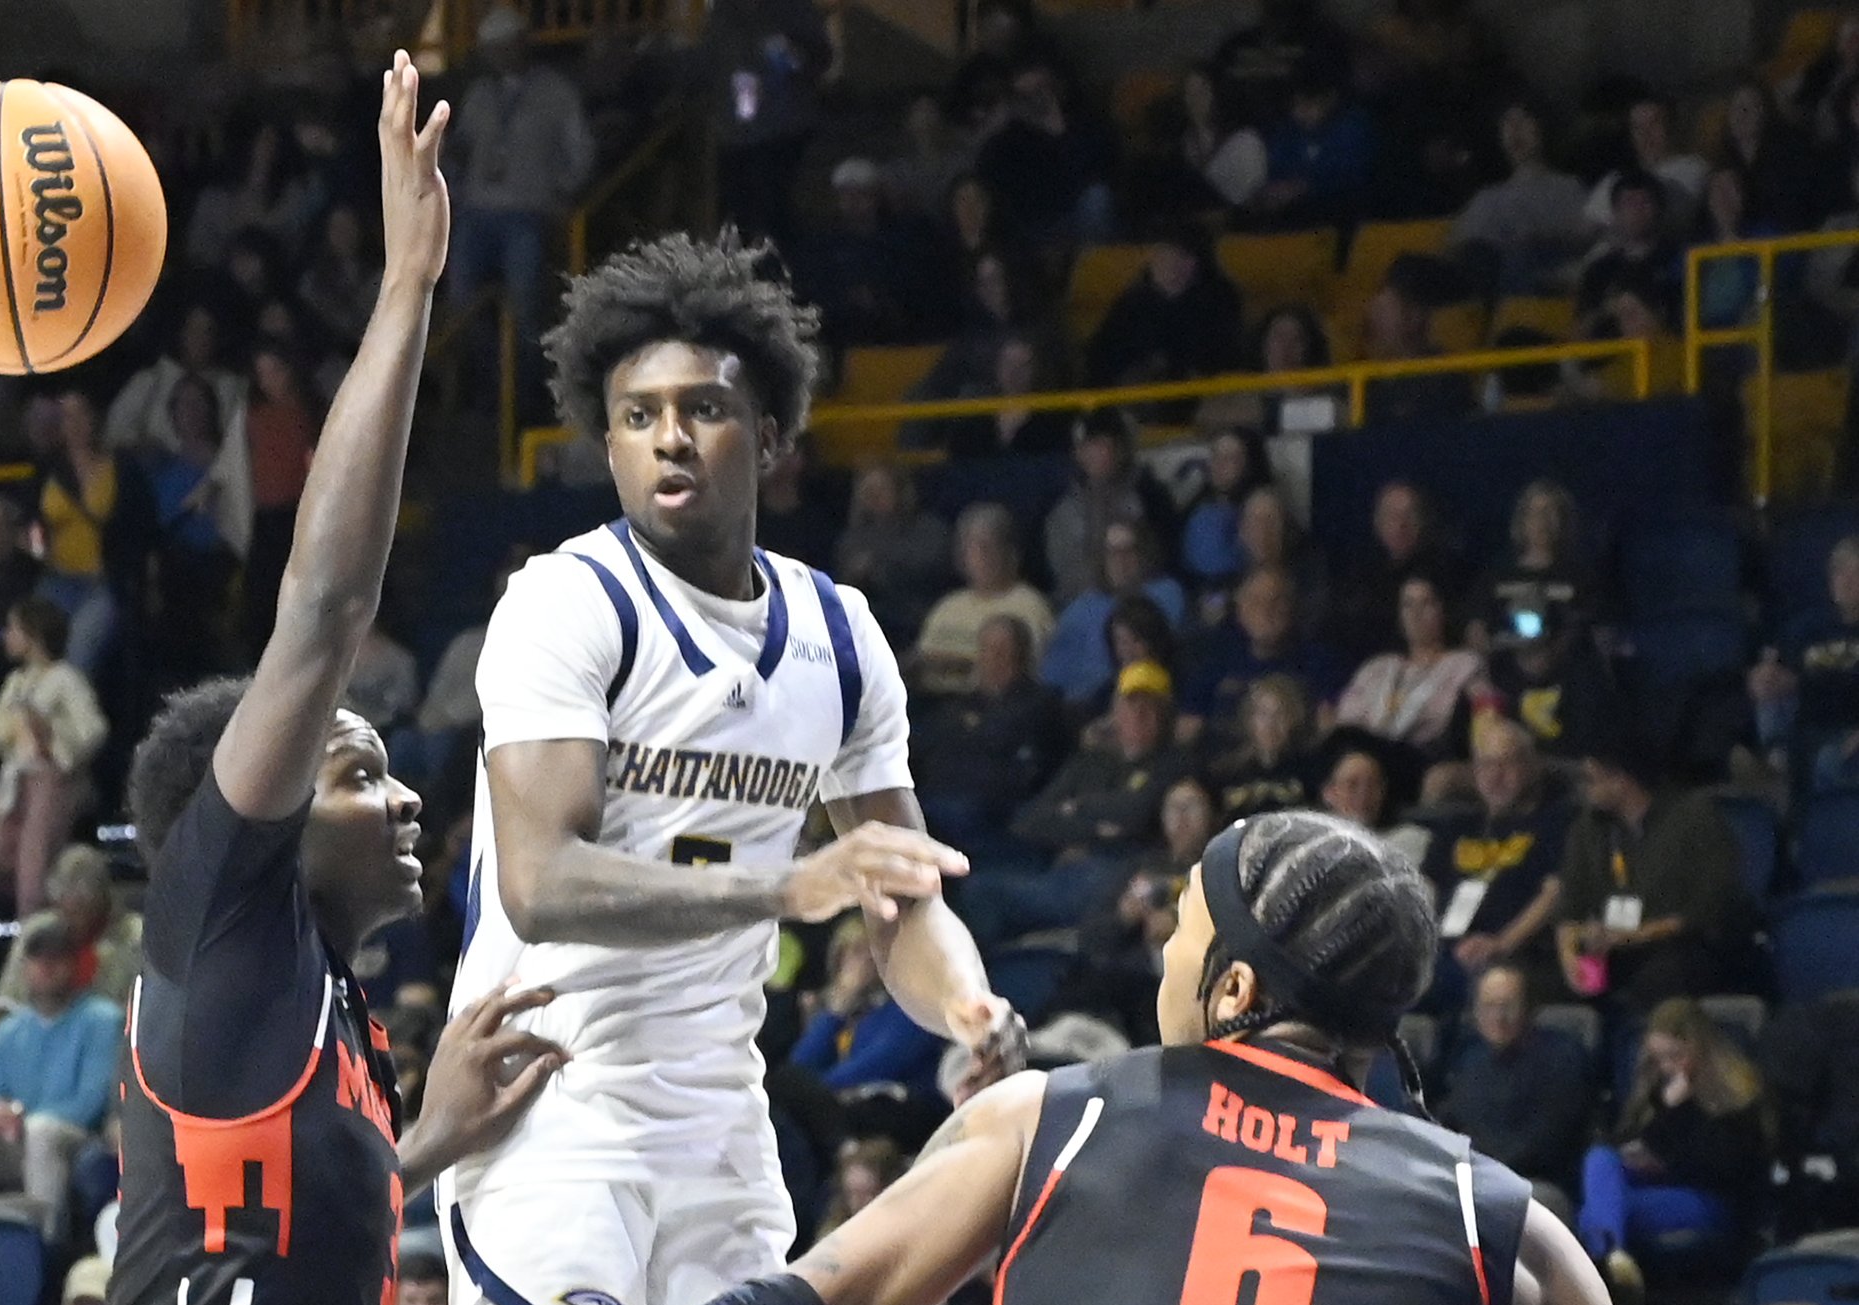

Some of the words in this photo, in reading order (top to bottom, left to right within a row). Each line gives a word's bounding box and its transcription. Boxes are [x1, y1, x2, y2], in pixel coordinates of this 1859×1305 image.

[21, 121, 83, 312] Wilson
[790, 637, 832, 664] SOCON
[606, 736, 820, 810] CHATTANOOGA
[1201, 1081, 1350, 1169] HOLT
